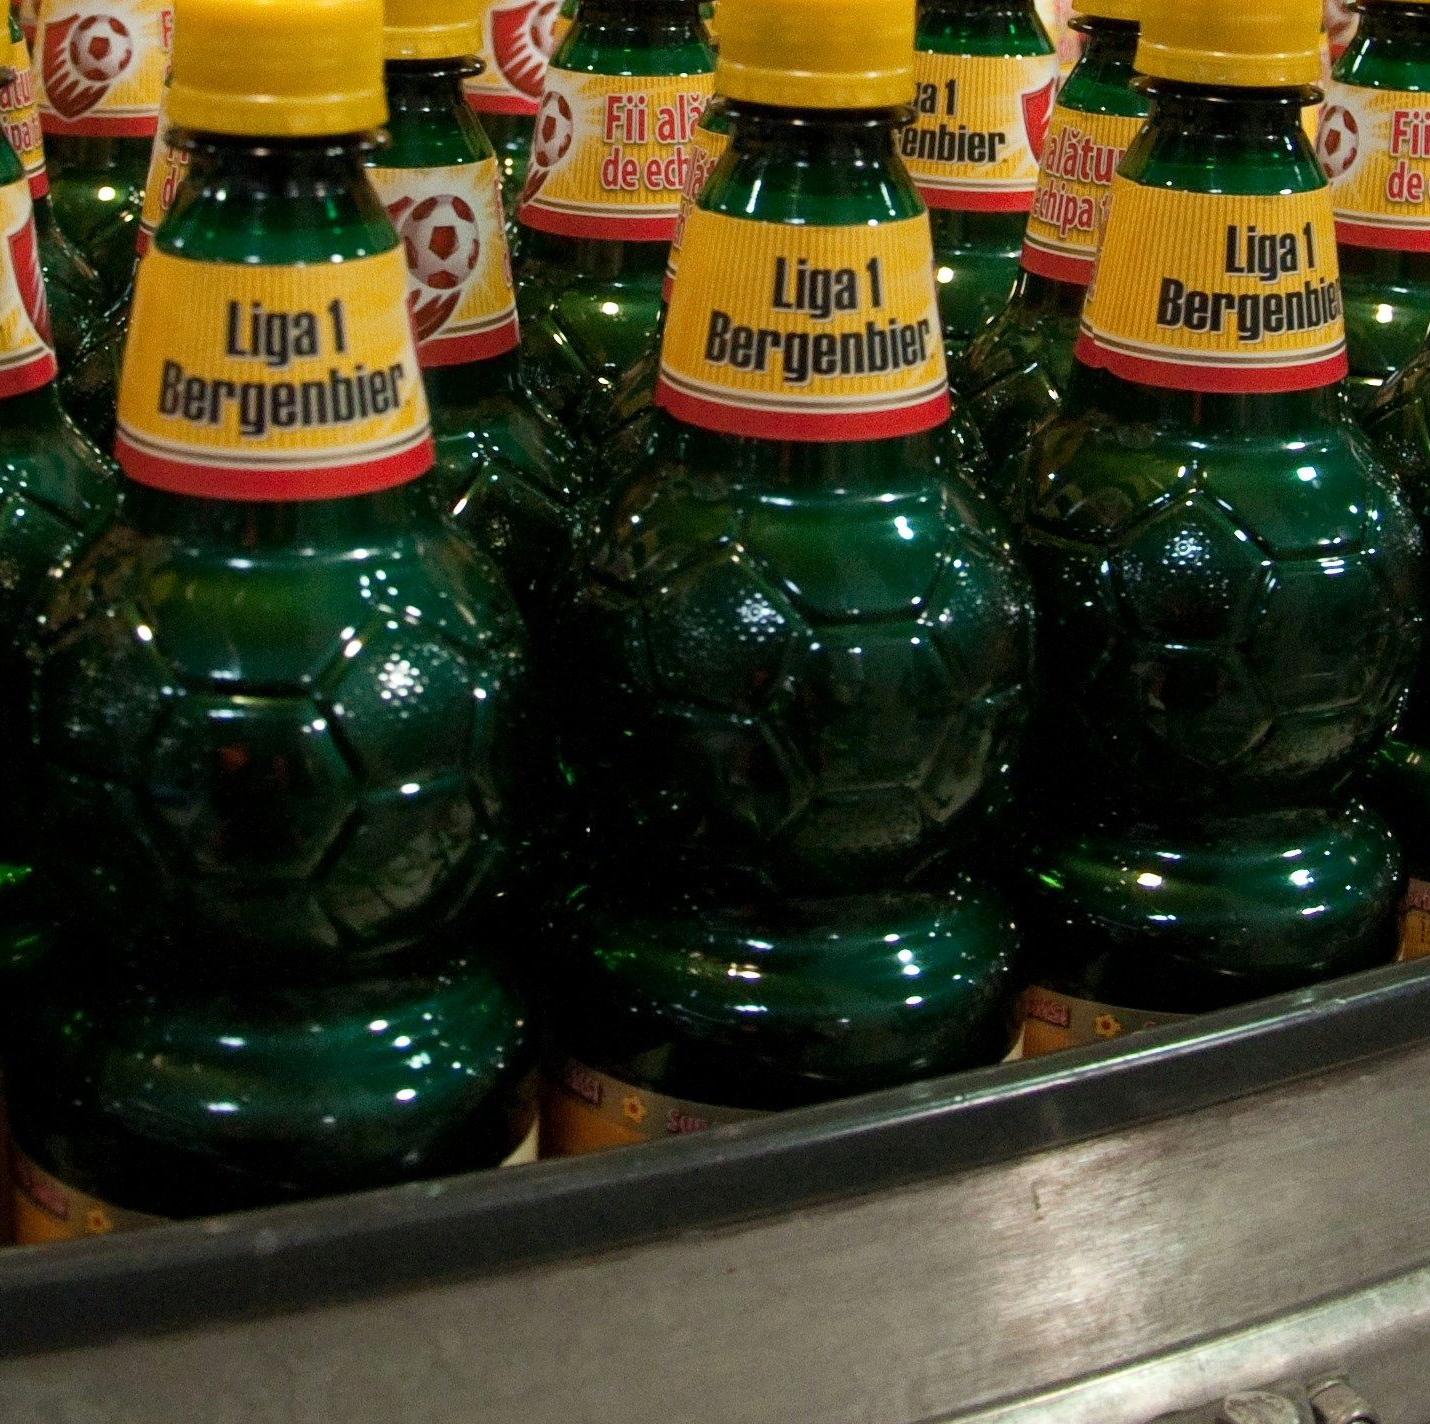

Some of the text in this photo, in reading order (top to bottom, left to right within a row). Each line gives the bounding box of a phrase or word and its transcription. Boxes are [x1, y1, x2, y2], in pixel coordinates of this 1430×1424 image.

[603, 91, 713, 144] Fii ală
[601, 145, 639, 191] de
[1386, 159, 1424, 204] de
[1224, 221, 1316, 284] Liga 1
[771, 255, 883, 321] Liga 1
[224, 297, 347, 369] Liga 1
[704, 308, 931, 384] Bergenbier
[157, 357, 406, 439] Bergenbier
